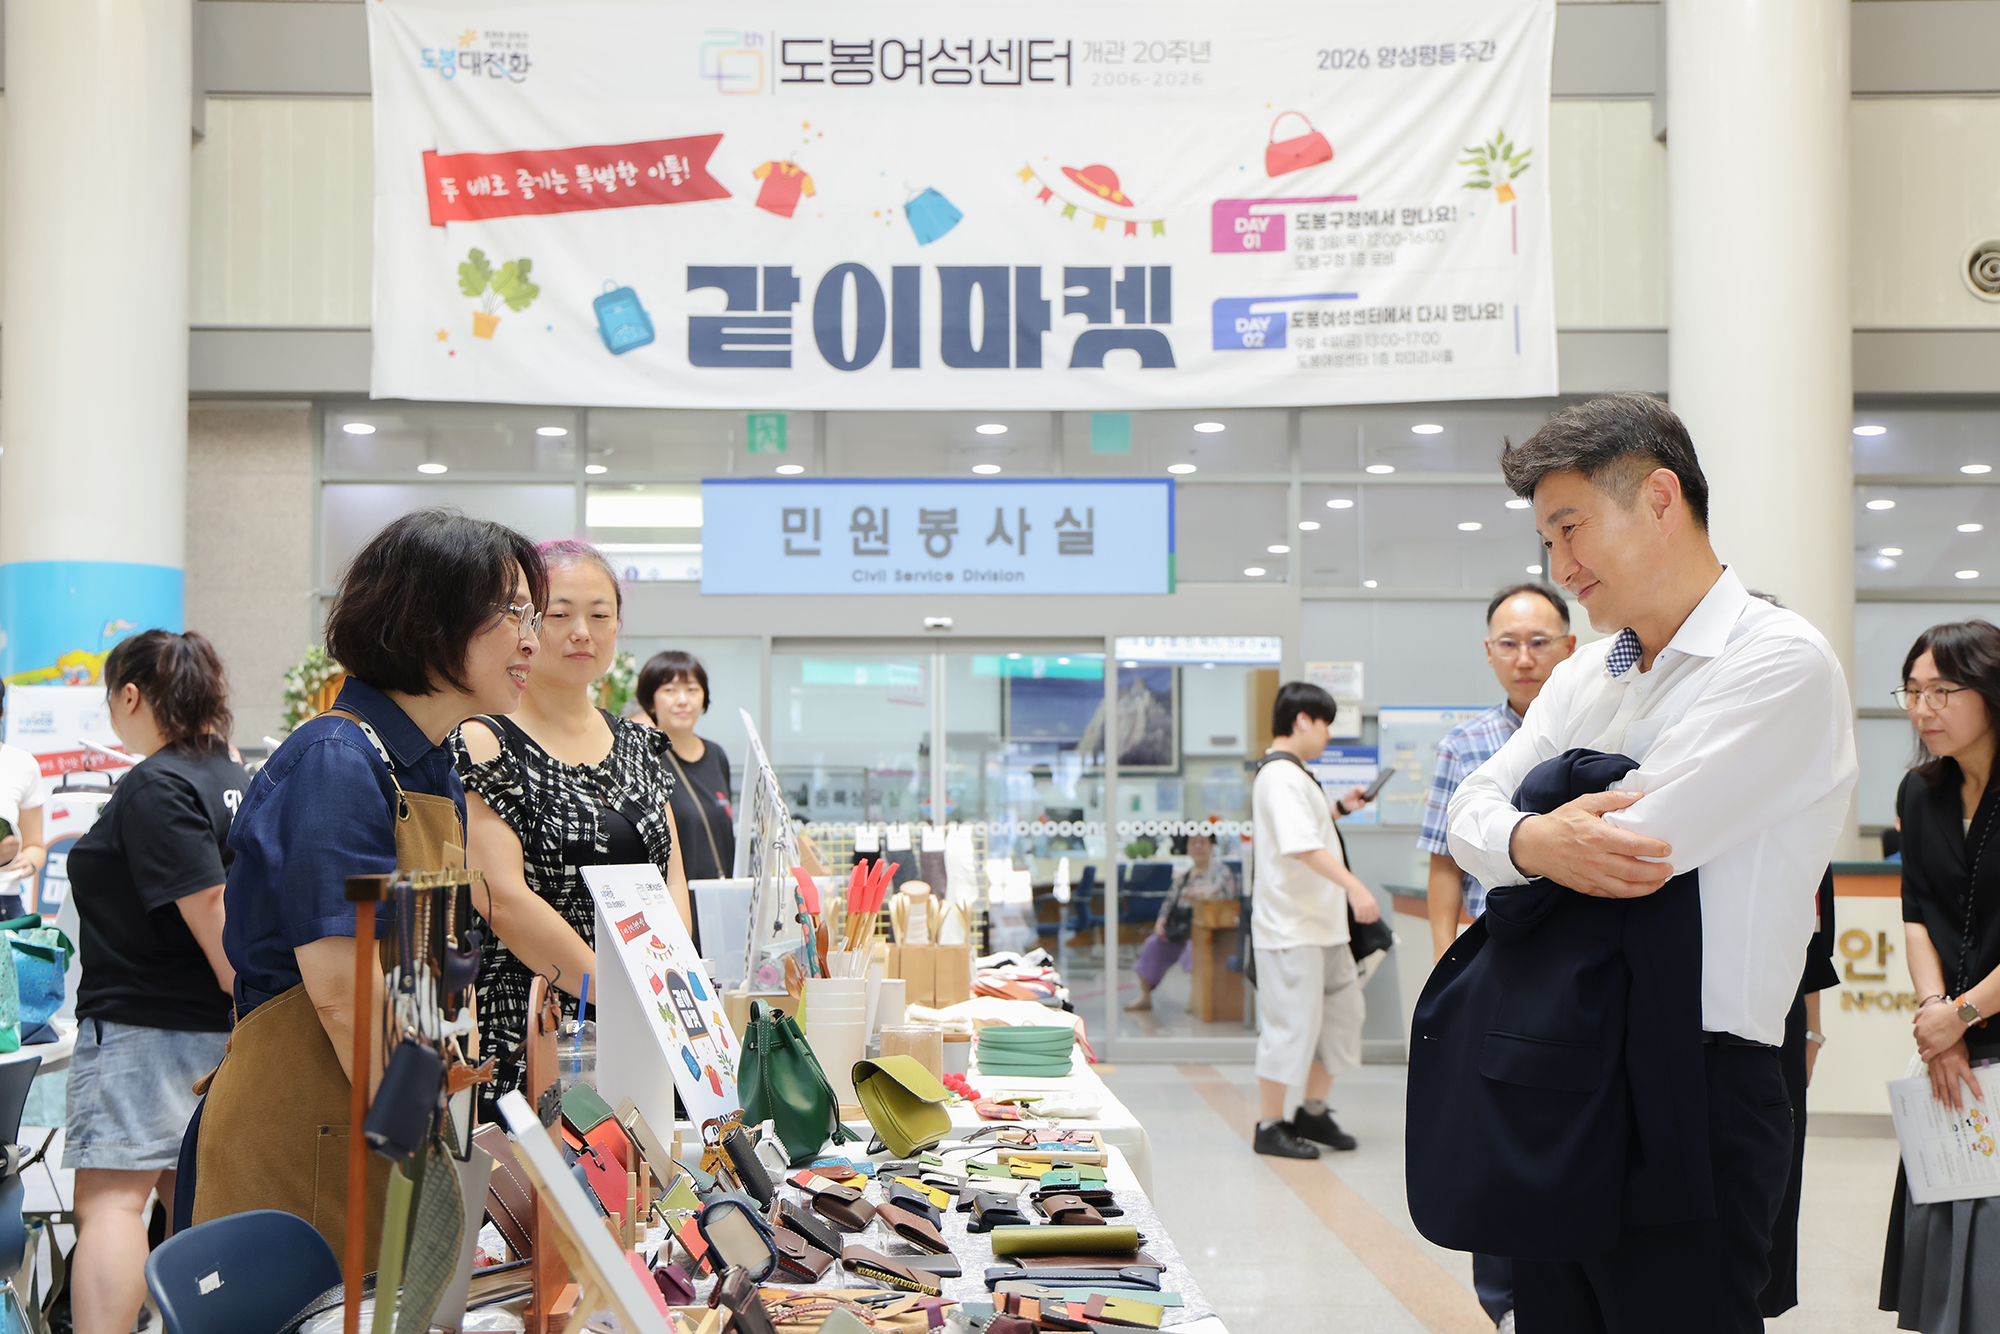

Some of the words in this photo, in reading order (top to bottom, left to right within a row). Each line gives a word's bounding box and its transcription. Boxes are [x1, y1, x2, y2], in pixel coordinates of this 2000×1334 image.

[781, 38, 1072, 86] 도봉여성센터
[1081, 40, 1125, 64] 개관
[1132, 39, 1212, 64] 20주년
[1317, 48, 1371, 70] 2026
[1377, 39, 1496, 69] 양성평등주간
[439, 177, 460, 204] 두
[466, 173, 510, 197] 배로
[516, 168, 569, 200] 즐기는
[574, 160, 639, 194] 특별한
[647, 153, 691, 186] 이틀!
[1234, 216, 1271, 233] DAY
[1295, 208, 1396, 231] 도봉구청에서
[1401, 205, 1458, 226] 만나요!
[1242, 232, 1262, 250] 01
[686, 262, 1176, 371] 같이마켓
[1234, 316, 1271, 333] DAY
[1291, 305, 1412, 329] 도봉여성센터에서
[1417, 305, 1448, 322] 다시
[1453, 302, 1504, 321] 만나요!
[1242, 331, 1266, 348] 02
[781, 506, 1095, 558] 민원봉사실
[852, 568, 886, 583] Civil
[894, 568, 953, 583] Service
[963, 568, 1025, 583] Division
